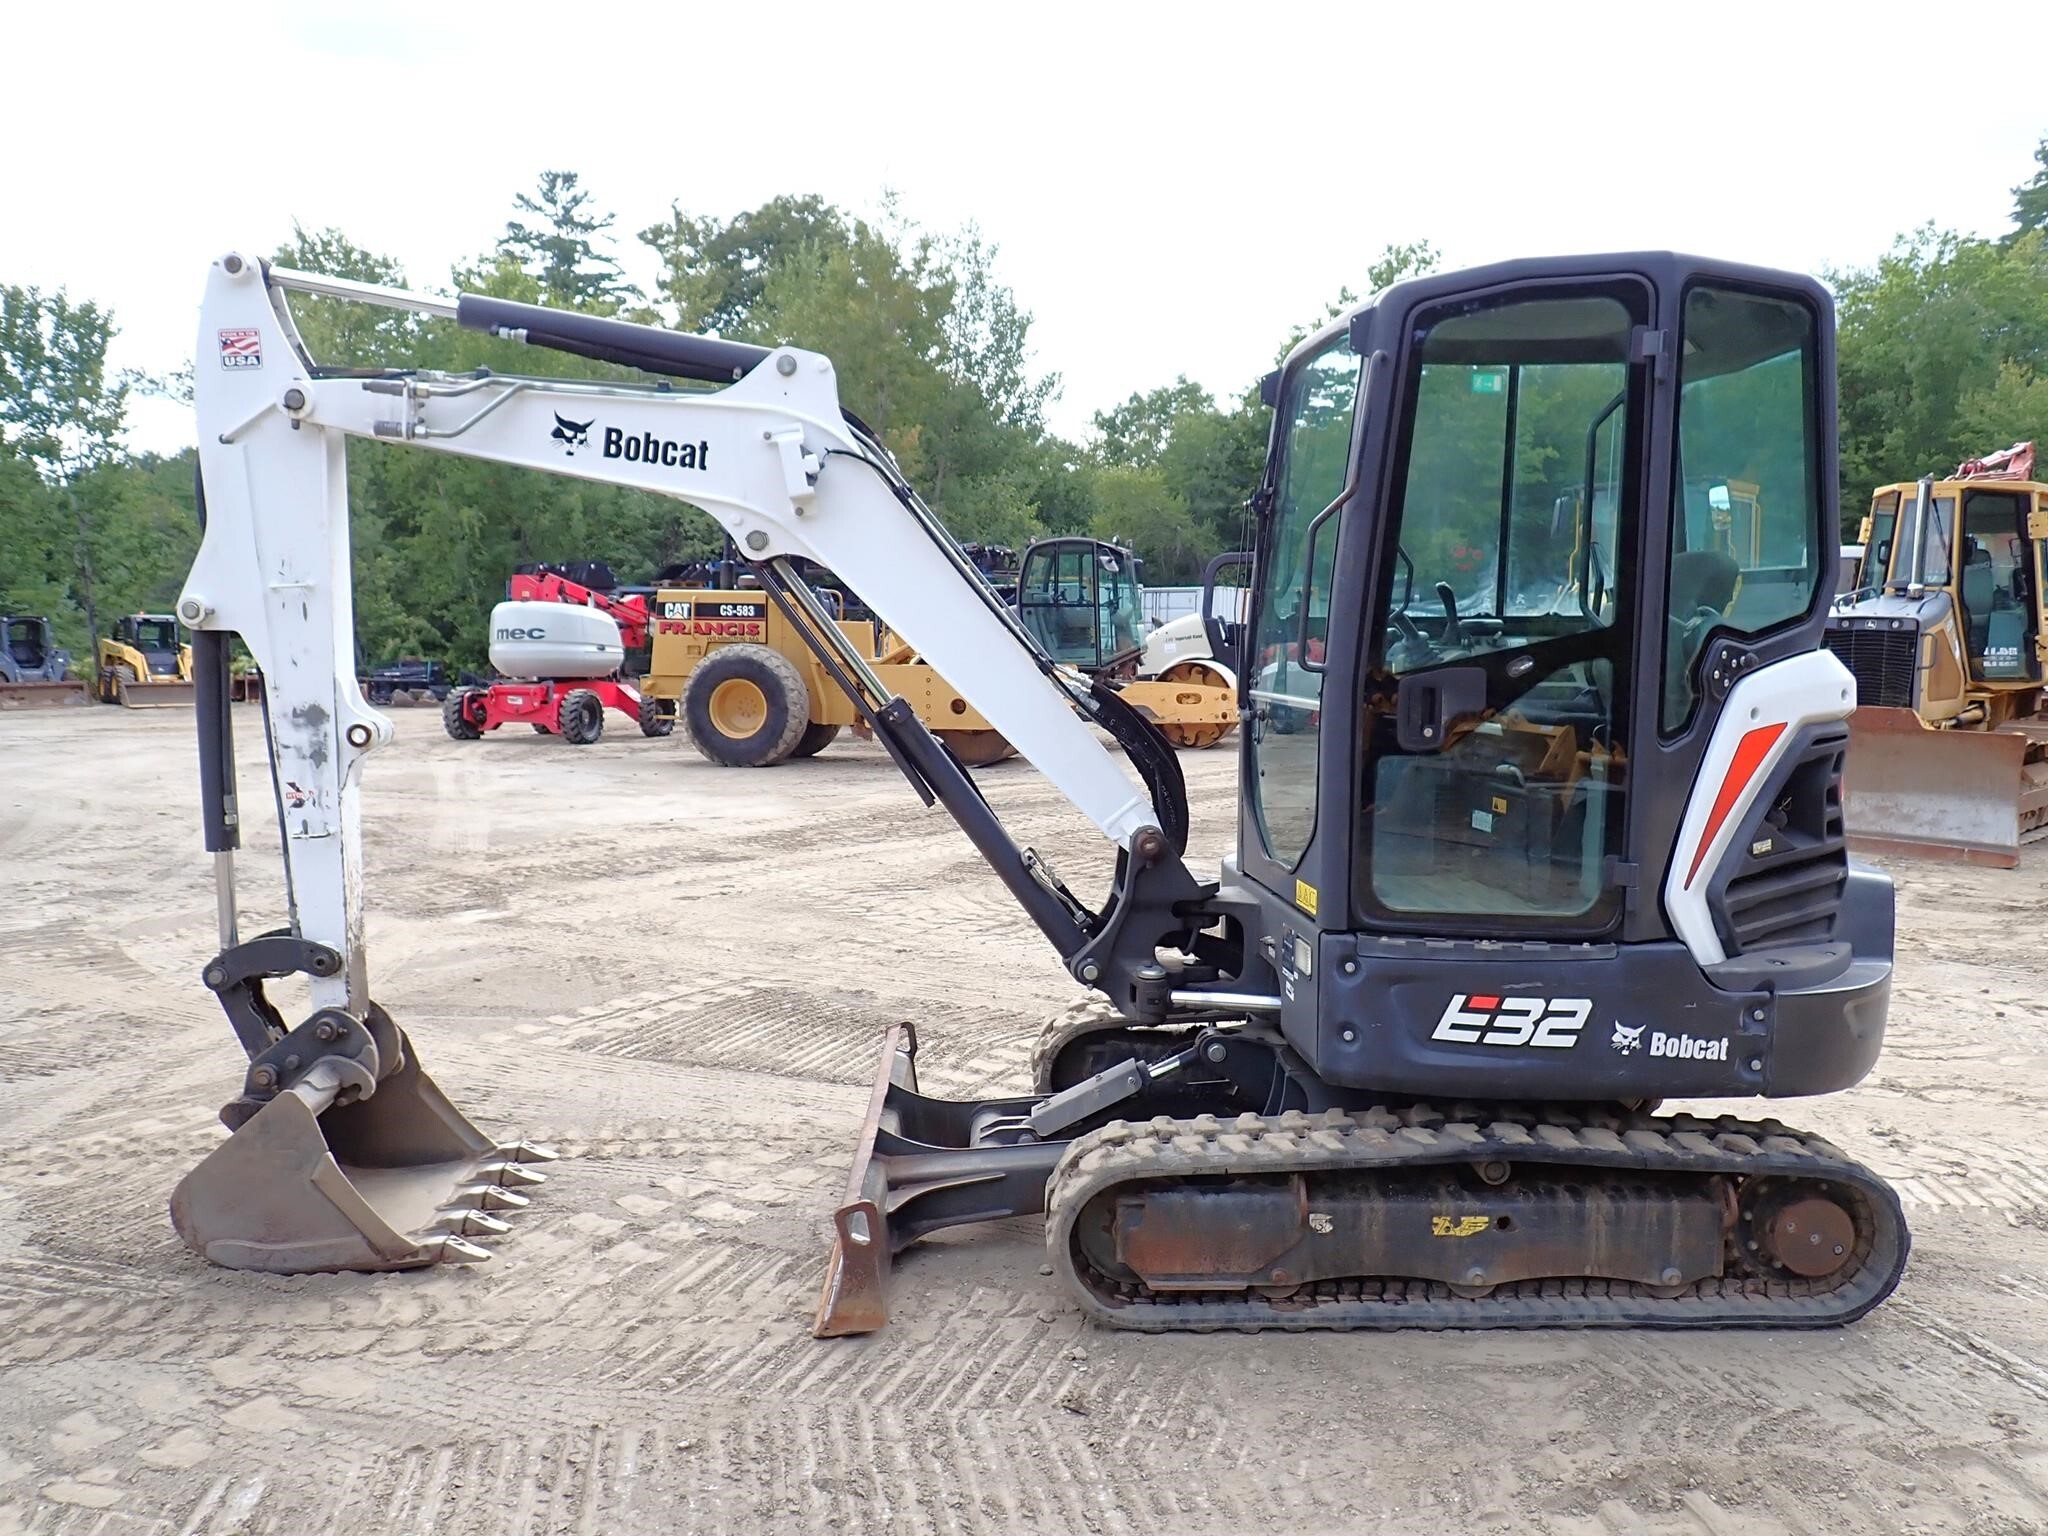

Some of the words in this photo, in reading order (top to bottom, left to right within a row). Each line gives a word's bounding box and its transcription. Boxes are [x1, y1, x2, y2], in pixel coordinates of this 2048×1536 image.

[223, 355, 261, 367] USA
[603, 426, 709, 471] Bobcat
[664, 602, 690, 620] CAT
[720, 604, 755, 616] CS-583
[496, 627, 546, 640] mec
[659, 621, 760, 636] FRANCIS
[1431, 994, 1593, 1048] E32
[1649, 1032, 1729, 1061] Bobcat
